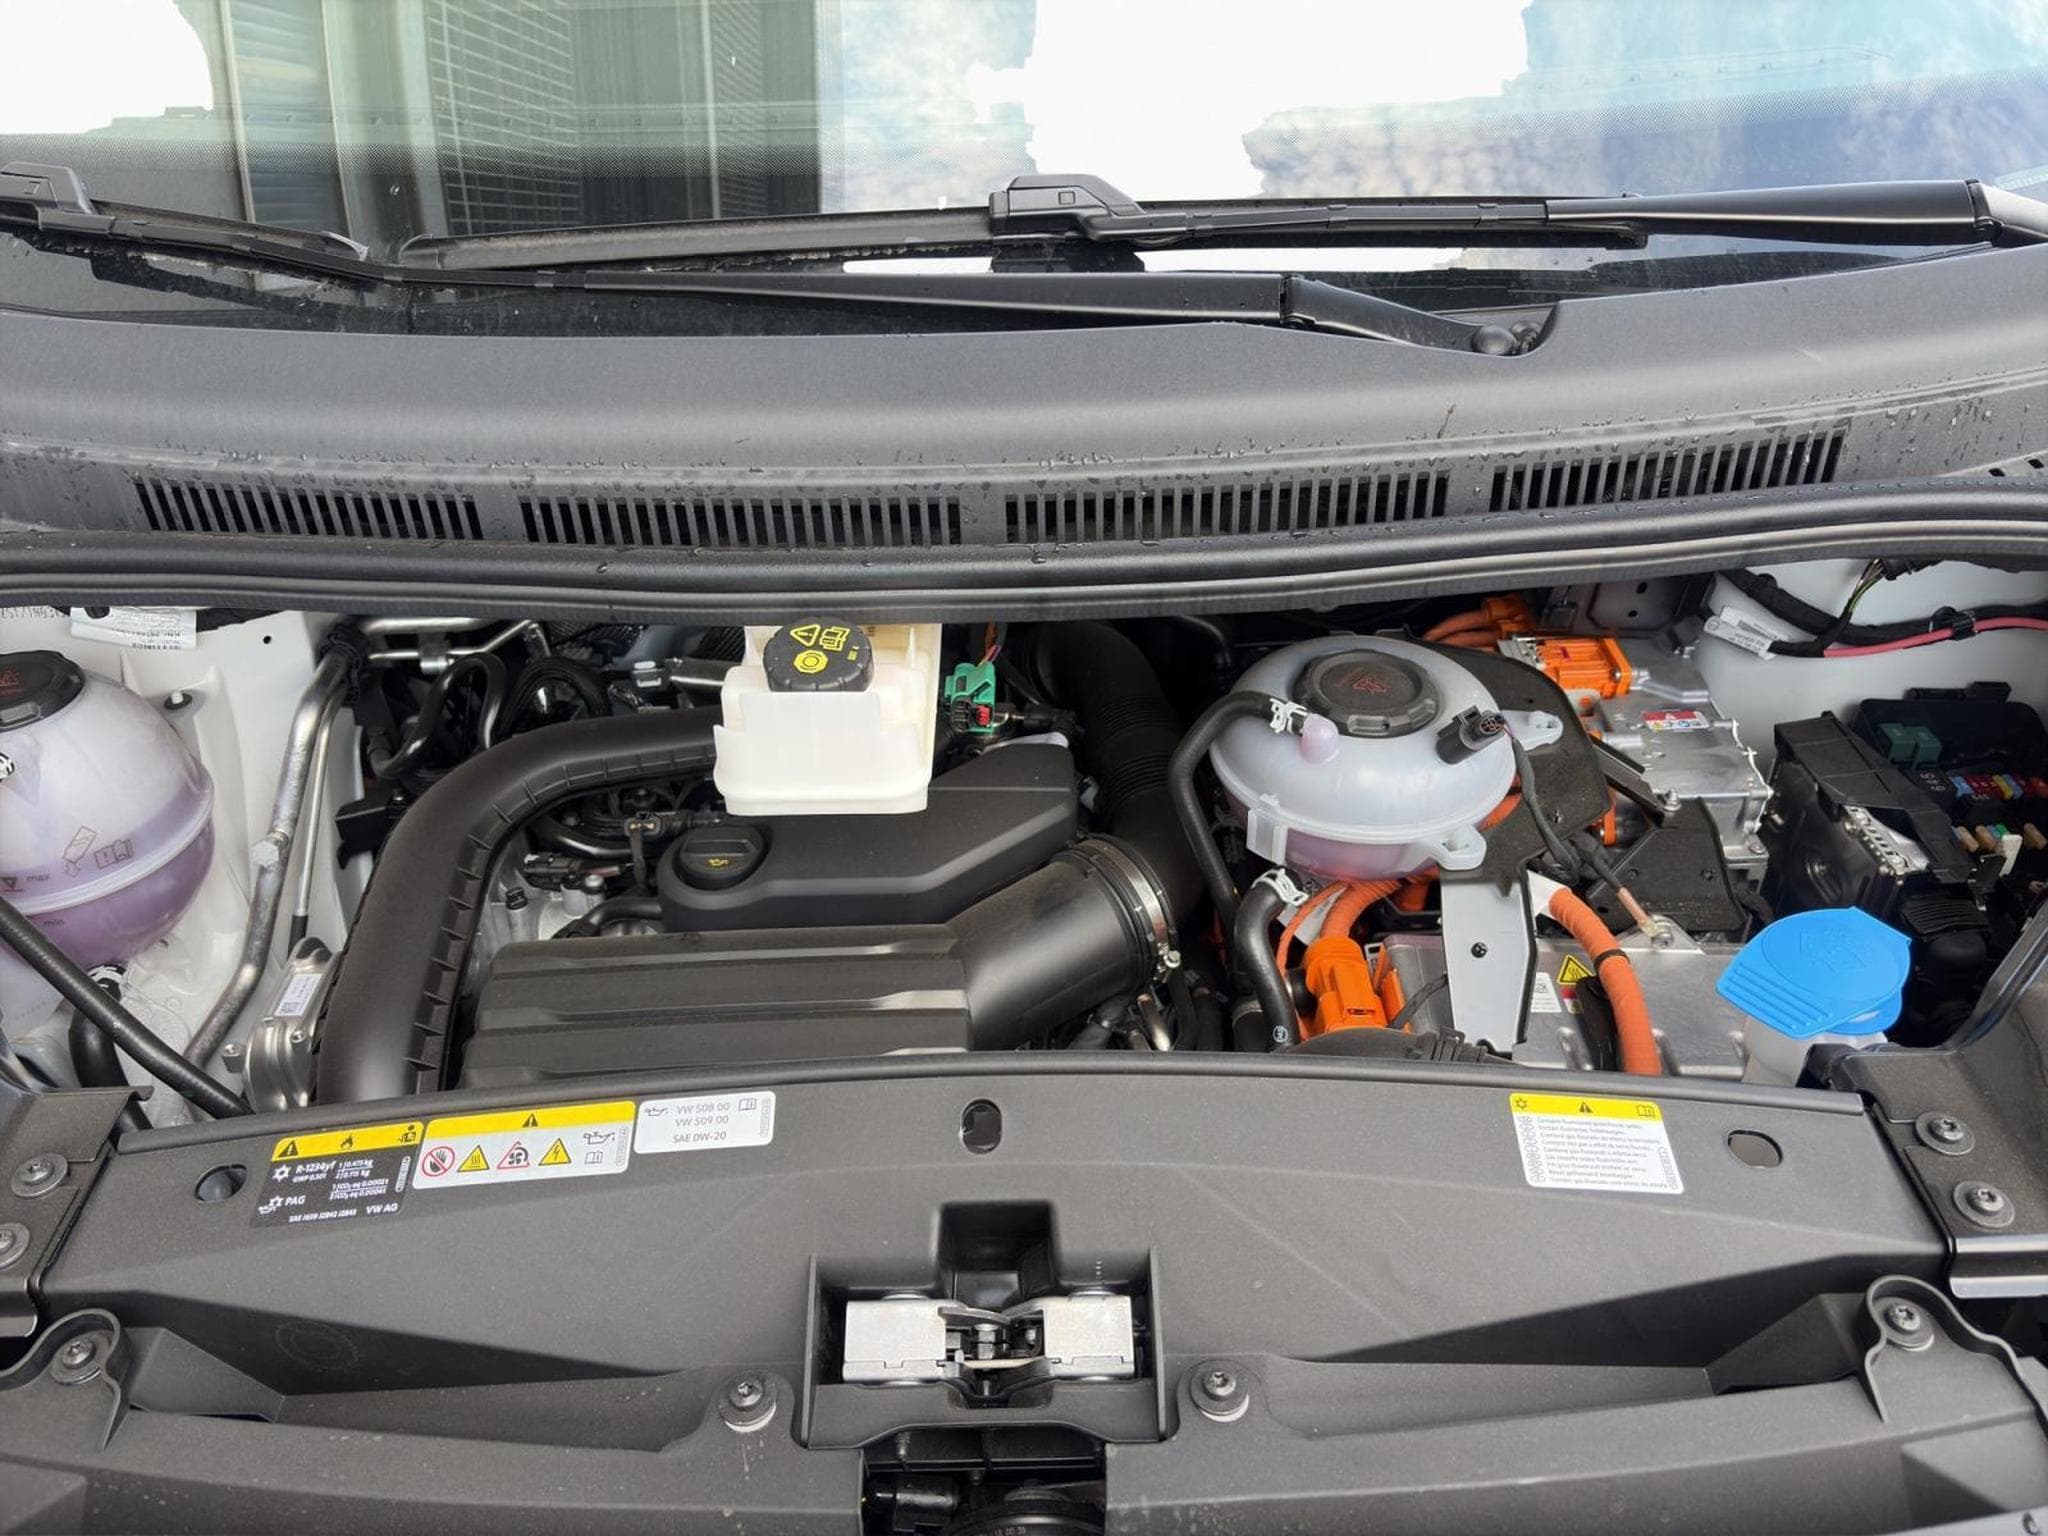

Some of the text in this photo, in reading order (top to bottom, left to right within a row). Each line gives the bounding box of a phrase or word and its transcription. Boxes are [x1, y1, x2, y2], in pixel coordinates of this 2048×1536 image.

[677, 1102, 730, 1115] VW 508 00
[675, 1115, 729, 1127] VW 509 00
[673, 1131, 727, 1143] SAE 0W-20
[295, 1160, 337, 1174] R-1234yf
[284, 1194, 307, 1206] PAG
[366, 1202, 399, 1214] VW AG
